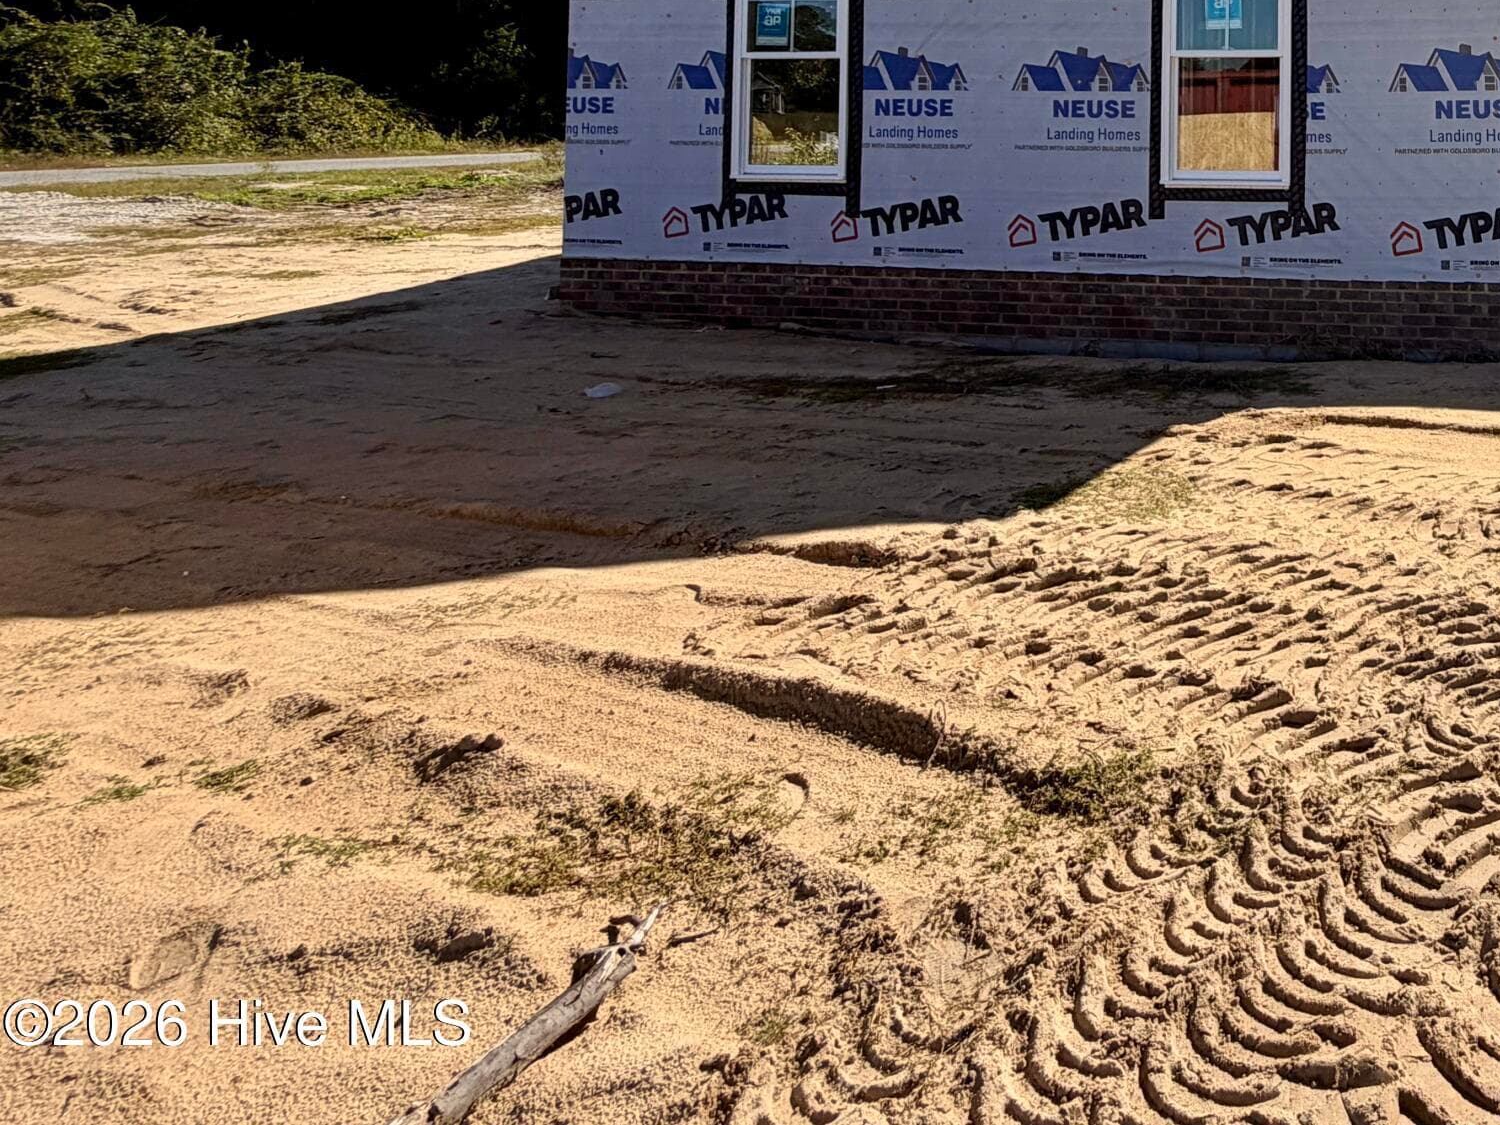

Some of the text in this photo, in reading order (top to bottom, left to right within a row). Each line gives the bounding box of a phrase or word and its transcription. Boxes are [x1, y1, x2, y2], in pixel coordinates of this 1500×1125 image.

[566, 96, 615, 114] USE
[875, 99, 953, 116] NEUSE
[1053, 100, 1136, 118] NEUSE
[582, 123, 618, 136] Homes
[869, 126, 958, 141] Landing Homes
[1047, 127, 1140, 143] Landing Homes
[1306, 132, 1332, 143] mes
[1430, 129, 1482, 146] Landing
[564, 188, 622, 223] PAR
[690, 192, 788, 232] TYPAR
[860, 195, 964, 236] TYPAR
[1037, 198, 1147, 241] TYPAR
[1226, 202, 1341, 246] TYPAR
